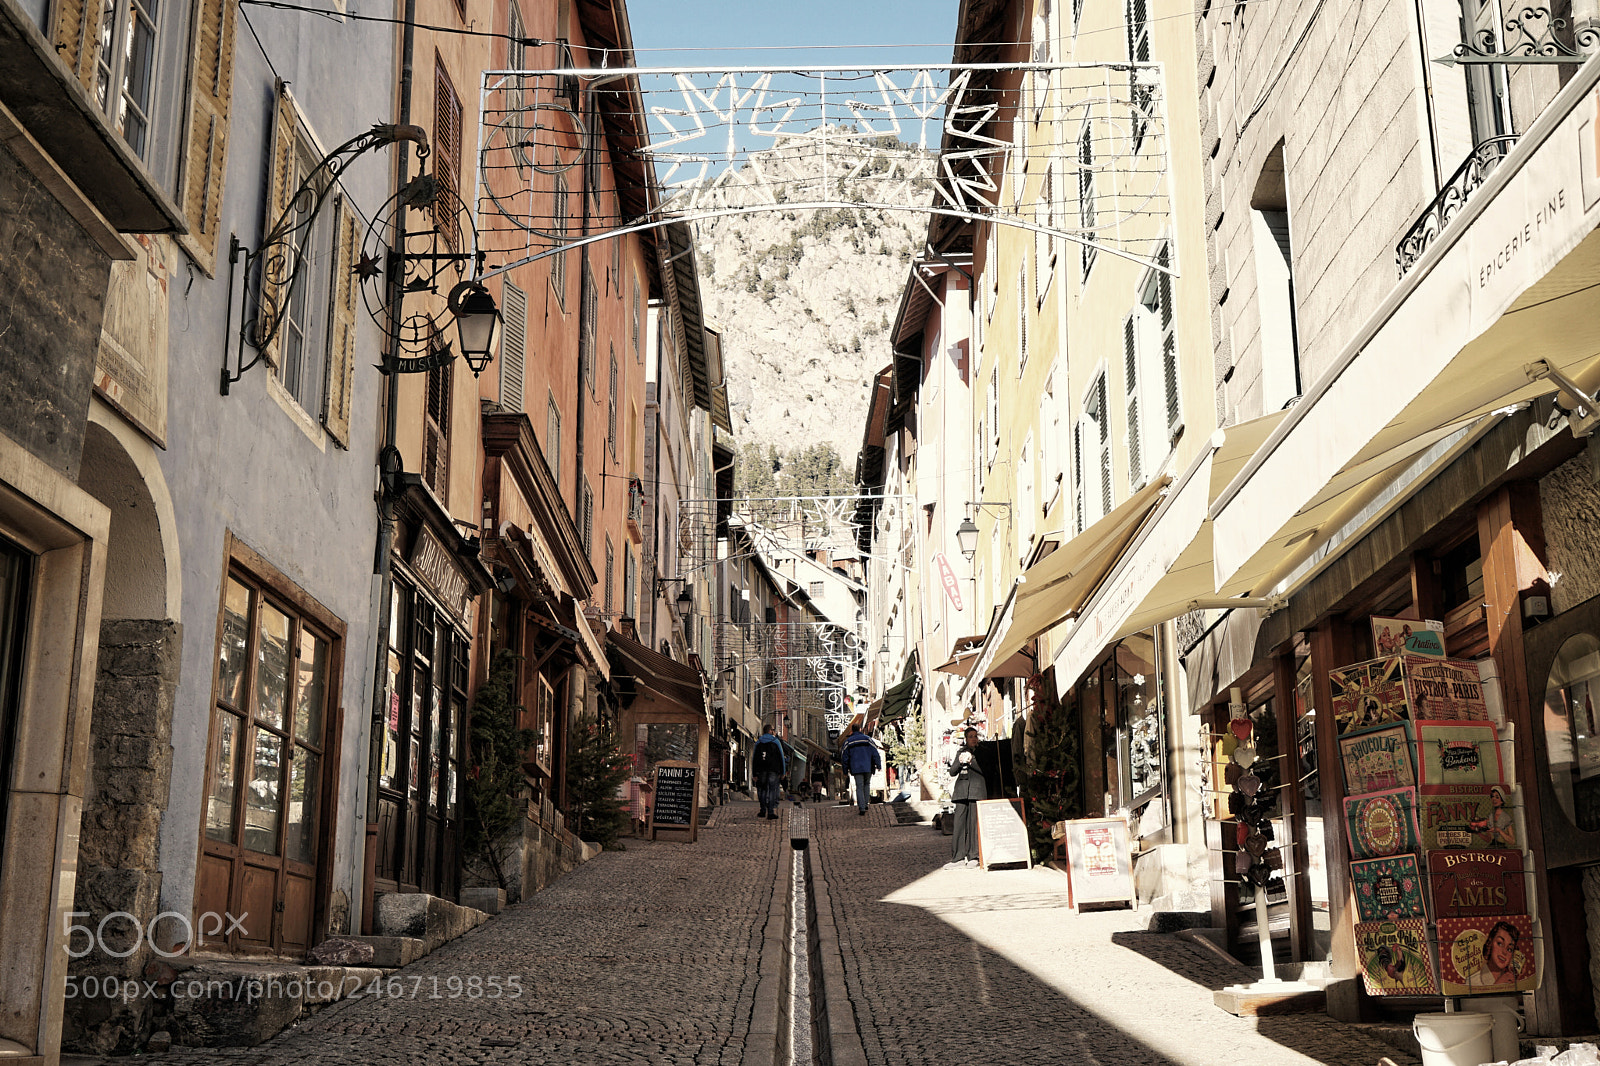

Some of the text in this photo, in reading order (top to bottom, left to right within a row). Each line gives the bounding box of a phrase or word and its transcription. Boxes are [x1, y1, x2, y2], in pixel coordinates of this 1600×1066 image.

[1480, 189, 1565, 288] ÉPICERIE FINE
[937, 554, 962, 608] TABAC
[1413, 679, 1448, 698] BISTROT
[1451, 682, 1480, 699] PARIS
[1351, 736, 1398, 761] CHOCOLAT
[659, 768, 683, 778] PANINI
[1449, 785, 1484, 794] BISTROT
[1426, 801, 1480, 829] FANNY
[1444, 852, 1507, 868] BISTROT
[1448, 886, 1508, 907] AMIS
